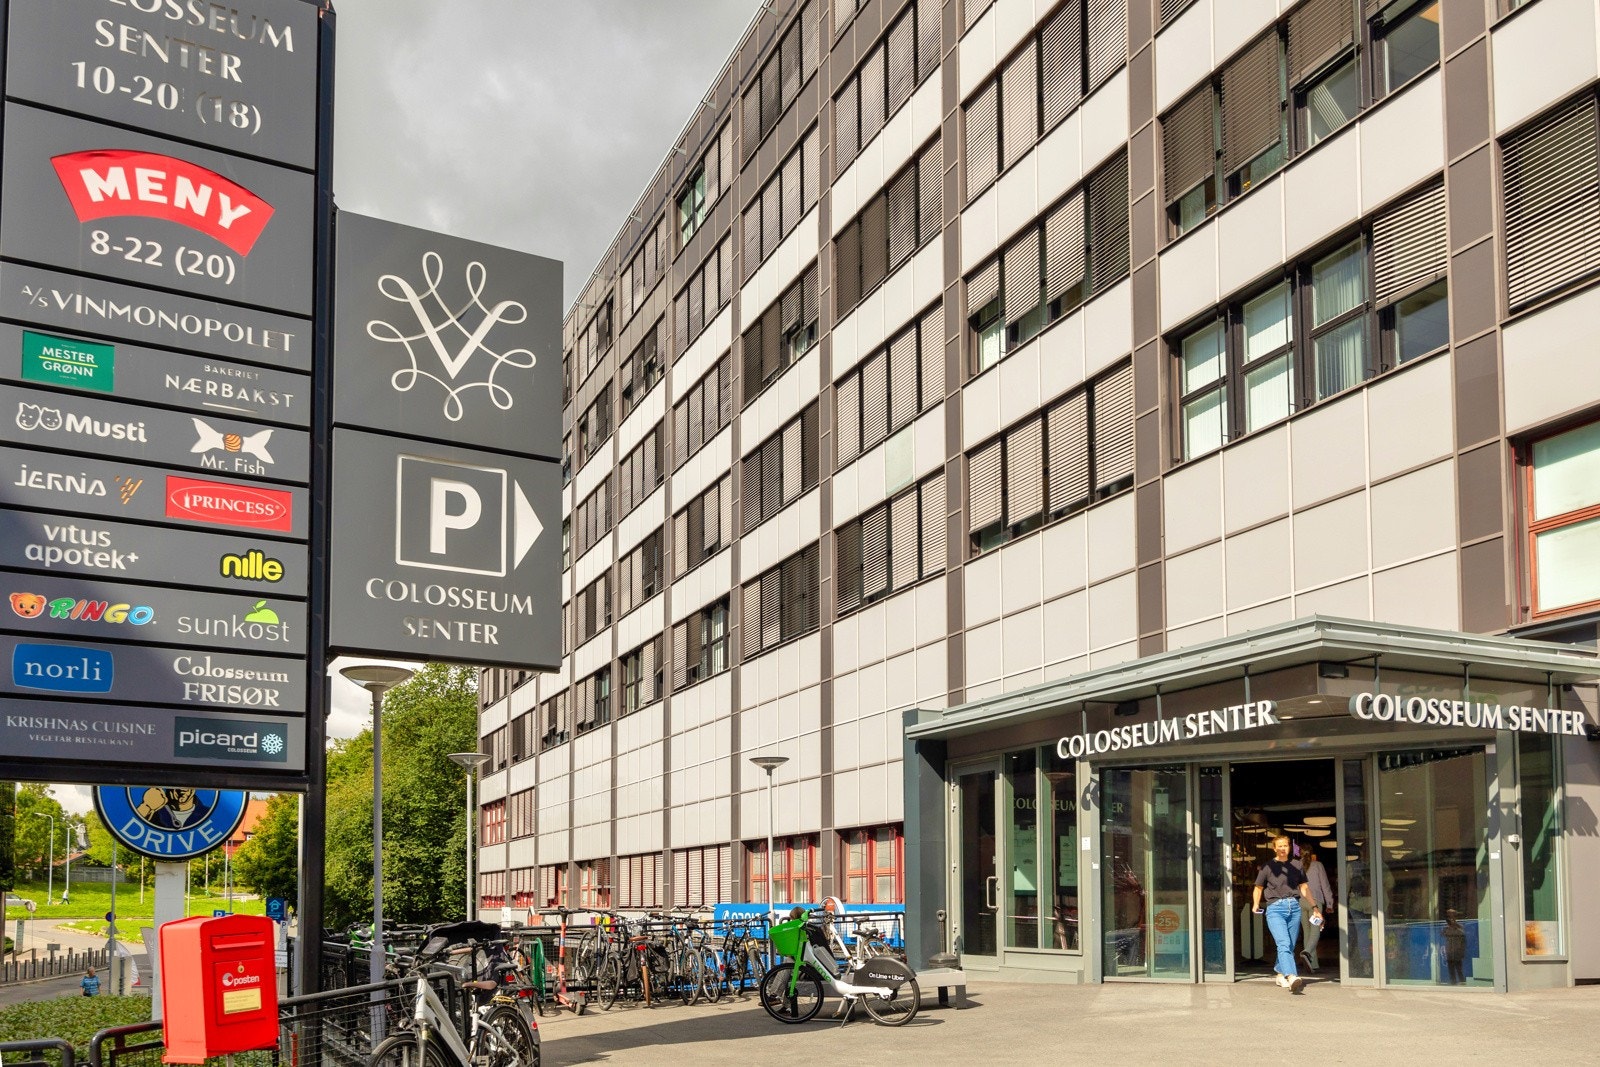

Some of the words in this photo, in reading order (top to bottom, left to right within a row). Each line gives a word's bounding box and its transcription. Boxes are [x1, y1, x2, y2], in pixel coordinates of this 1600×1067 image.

[94, 18, 243, 84] SENTER
[71, 61, 179, 111] 10-20
[195, 91, 263, 136] (18)
[79, 166, 252, 230] MENY
[90, 229, 163, 268] 8-22
[174, 246, 236, 285] (20)
[50, 288, 296, 352] VINMONOPOLET
[42, 346, 95, 364] MESTER
[42, 360, 94, 377] GRØNN
[203, 364, 260, 381] BAKERIET
[164, 373, 295, 408] NÆRBAKST
[65, 412, 148, 443] Musti
[200, 453, 229, 471] Mr.
[234, 455, 266, 476] Fish
[429, 476, 482, 555] P
[43, 523, 111, 547] vitus
[221, 551, 283, 582] nille
[365, 577, 534, 616] COLOSSEUM
[177, 615, 290, 642] sunkost
[402, 615, 499, 646] SENTER
[24, 657, 103, 682] norli
[172, 655, 289, 684] Colosseum
[182, 681, 280, 707] FRISØR
[6, 715, 88, 732] KRISHNAS
[92, 720, 157, 736] CUISINE
[1355, 691, 1504, 730] COLOSSEUM
[1508, 704, 1587, 736] SENTER
[29, 733, 72, 744] VEGETAR
[75, 735, 134, 747] RESTAURANT
[179, 729, 258, 748] picard
[1056, 716, 1181, 760] COLOSSEUM
[1185, 700, 1275, 740] SENTER
[120, 816, 224, 854] DRIVE
[233, 974, 260, 987] posten
